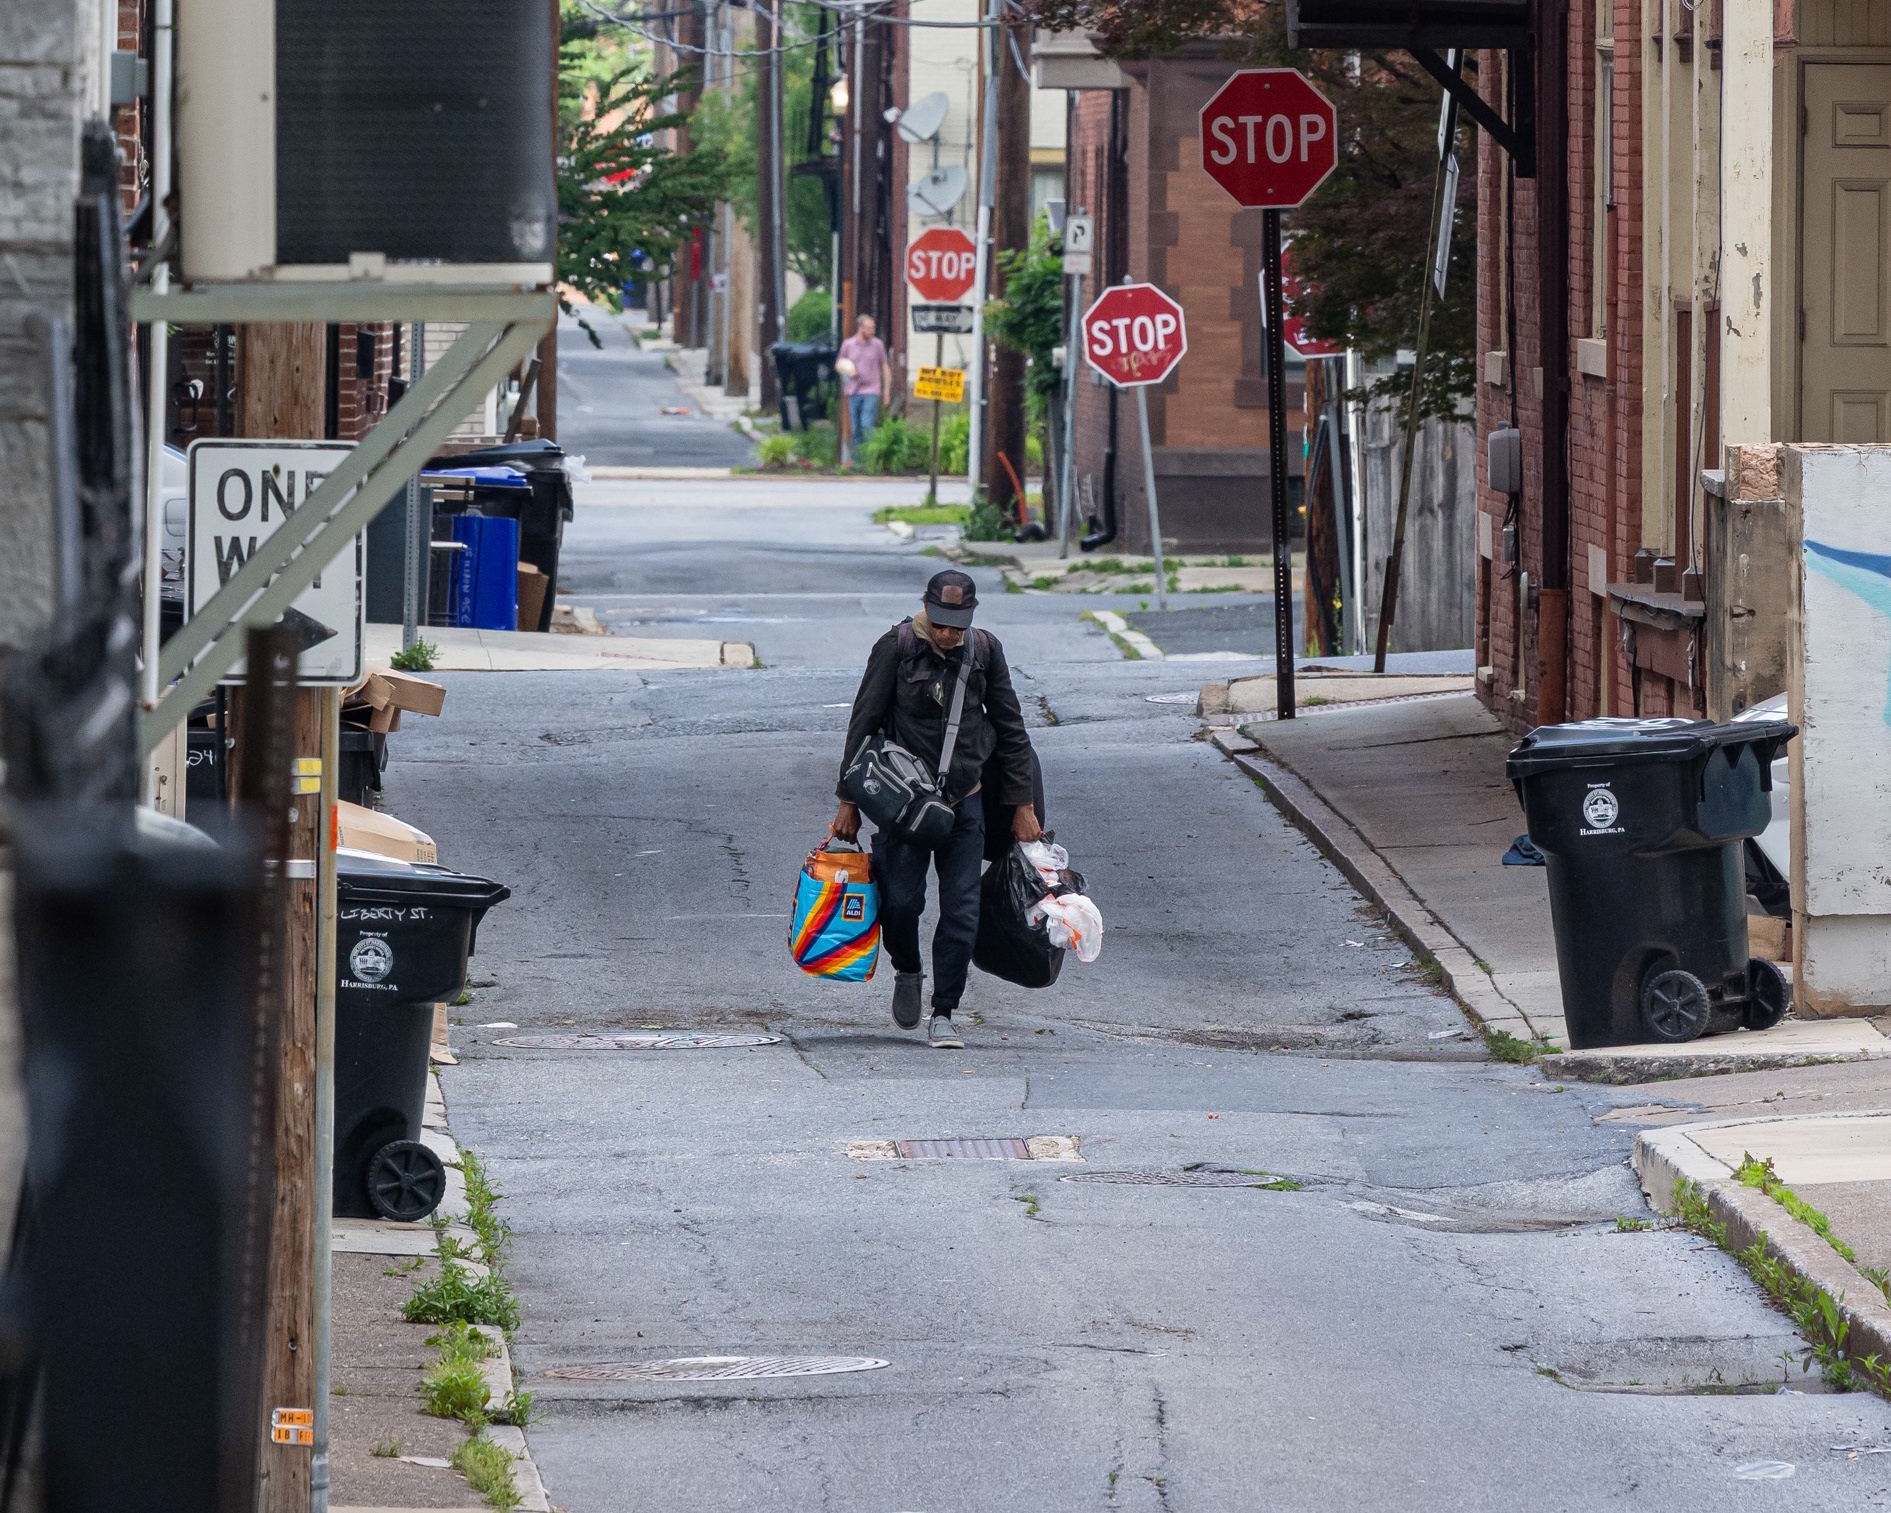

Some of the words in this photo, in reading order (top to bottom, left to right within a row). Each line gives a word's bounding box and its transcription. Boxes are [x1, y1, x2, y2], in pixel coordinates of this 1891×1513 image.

[1210, 114, 1327, 166] STOP
[909, 249, 976, 281] STOP
[1091, 313, 1177, 357] STOP
[341, 907, 406, 921] LIBERTY
